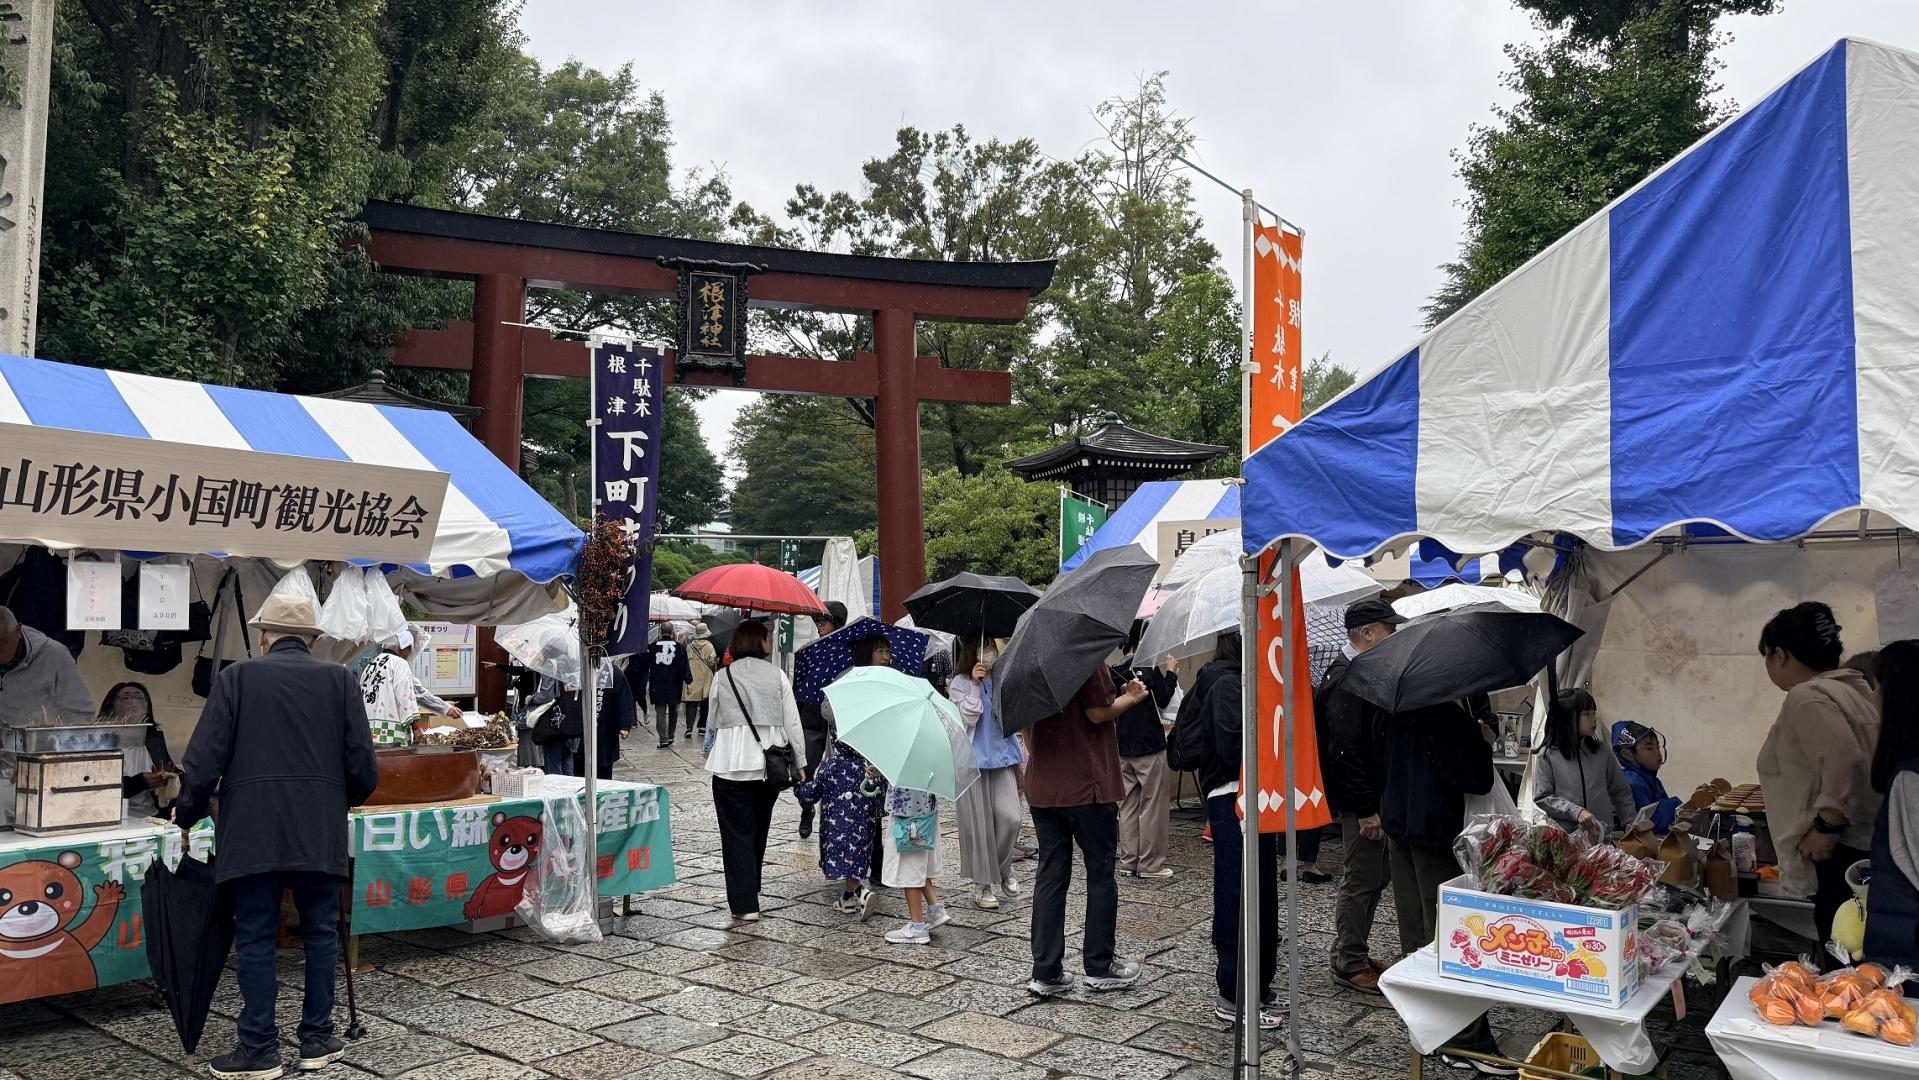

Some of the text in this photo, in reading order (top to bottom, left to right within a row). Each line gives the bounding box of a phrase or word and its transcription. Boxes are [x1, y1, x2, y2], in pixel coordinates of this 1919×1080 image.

[607, 354, 627, 416] 根津
[632, 358, 652, 417] 千駄木
[0, 458, 429, 540] 山形県小国町観光協会
[362, 805, 489, 851] 白い森
[366, 871, 468, 907] 山形県
[1499, 952, 1550, 968] ミニゼリー
